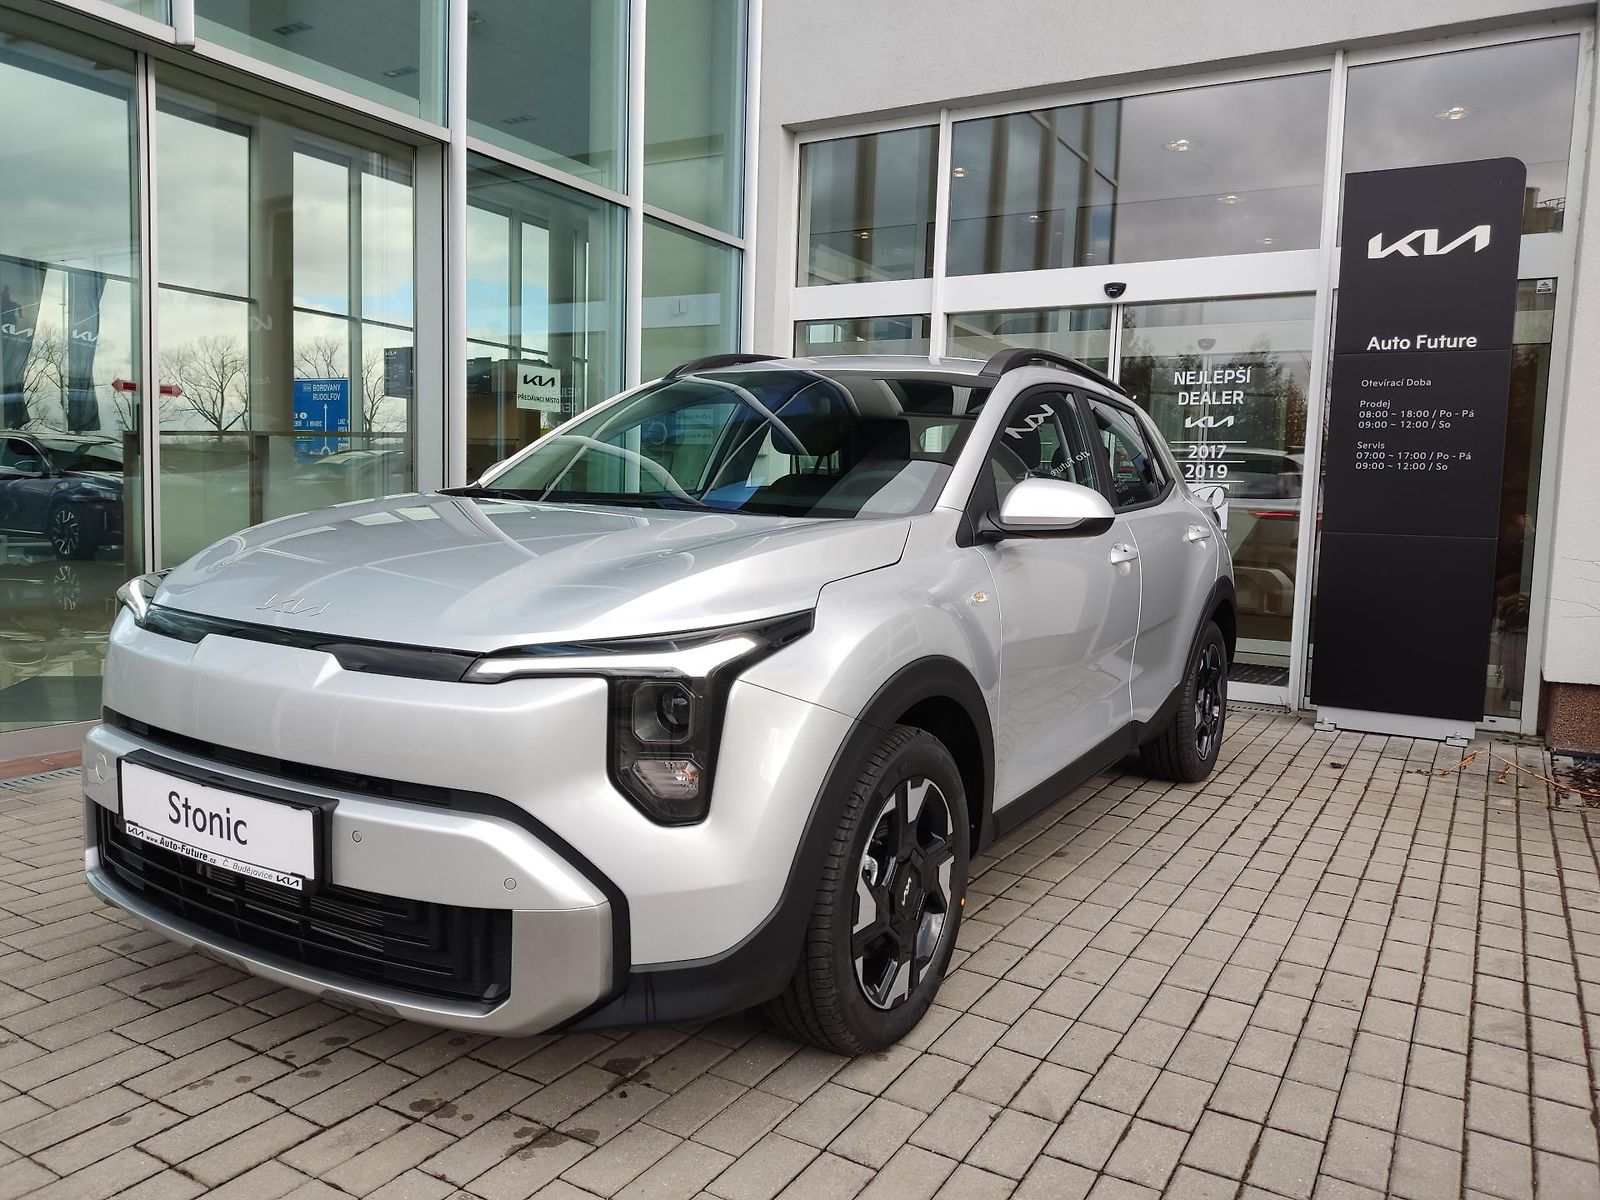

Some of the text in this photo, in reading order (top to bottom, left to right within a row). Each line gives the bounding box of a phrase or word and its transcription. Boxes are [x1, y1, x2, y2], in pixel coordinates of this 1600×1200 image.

[1367, 224, 1491, 259] KIA
[1366, 334, 1478, 351] Auto Future
[523, 374, 556, 387] KIA
[1173, 366, 1252, 385] NEJLEPŠÍ
[1361, 378, 1432, 388] Otevírací Doba
[1177, 390, 1244, 406] DEALER
[1359, 400, 1391, 409] Prodej
[1358, 410, 1388, 419] 08:00
[1400, 410, 1430, 418] 18:00
[1439, 410, 1452, 418] Po
[1461, 409, 1475, 418] Pá
[1184, 415, 1235, 428] KIA
[1358, 420, 1388, 429] 09:00
[1400, 420, 1429, 429] 12:00
[1438, 420, 1451, 429] So
[1188, 445, 1227, 459] 2017
[1356, 441, 1385, 450] Servis
[1356, 451, 1386, 460] 07:00
[1398, 451, 1427, 460] 17:00
[1436, 452, 1450, 460] Po
[1458, 452, 1472, 460] Pá
[1184, 464, 1228, 479] 2019
[1355, 462, 1385, 470] 09:00
[1396, 462, 1426, 470] 12:00
[1435, 463, 1448, 471] So
[168, 790, 248, 846] Stonic
[127, 826, 144, 838] KIA
[146, 835, 217, 865] www.Auto-Future.cz
[232, 862, 274, 880] Budějovice
[276, 874, 299, 887] KIA
